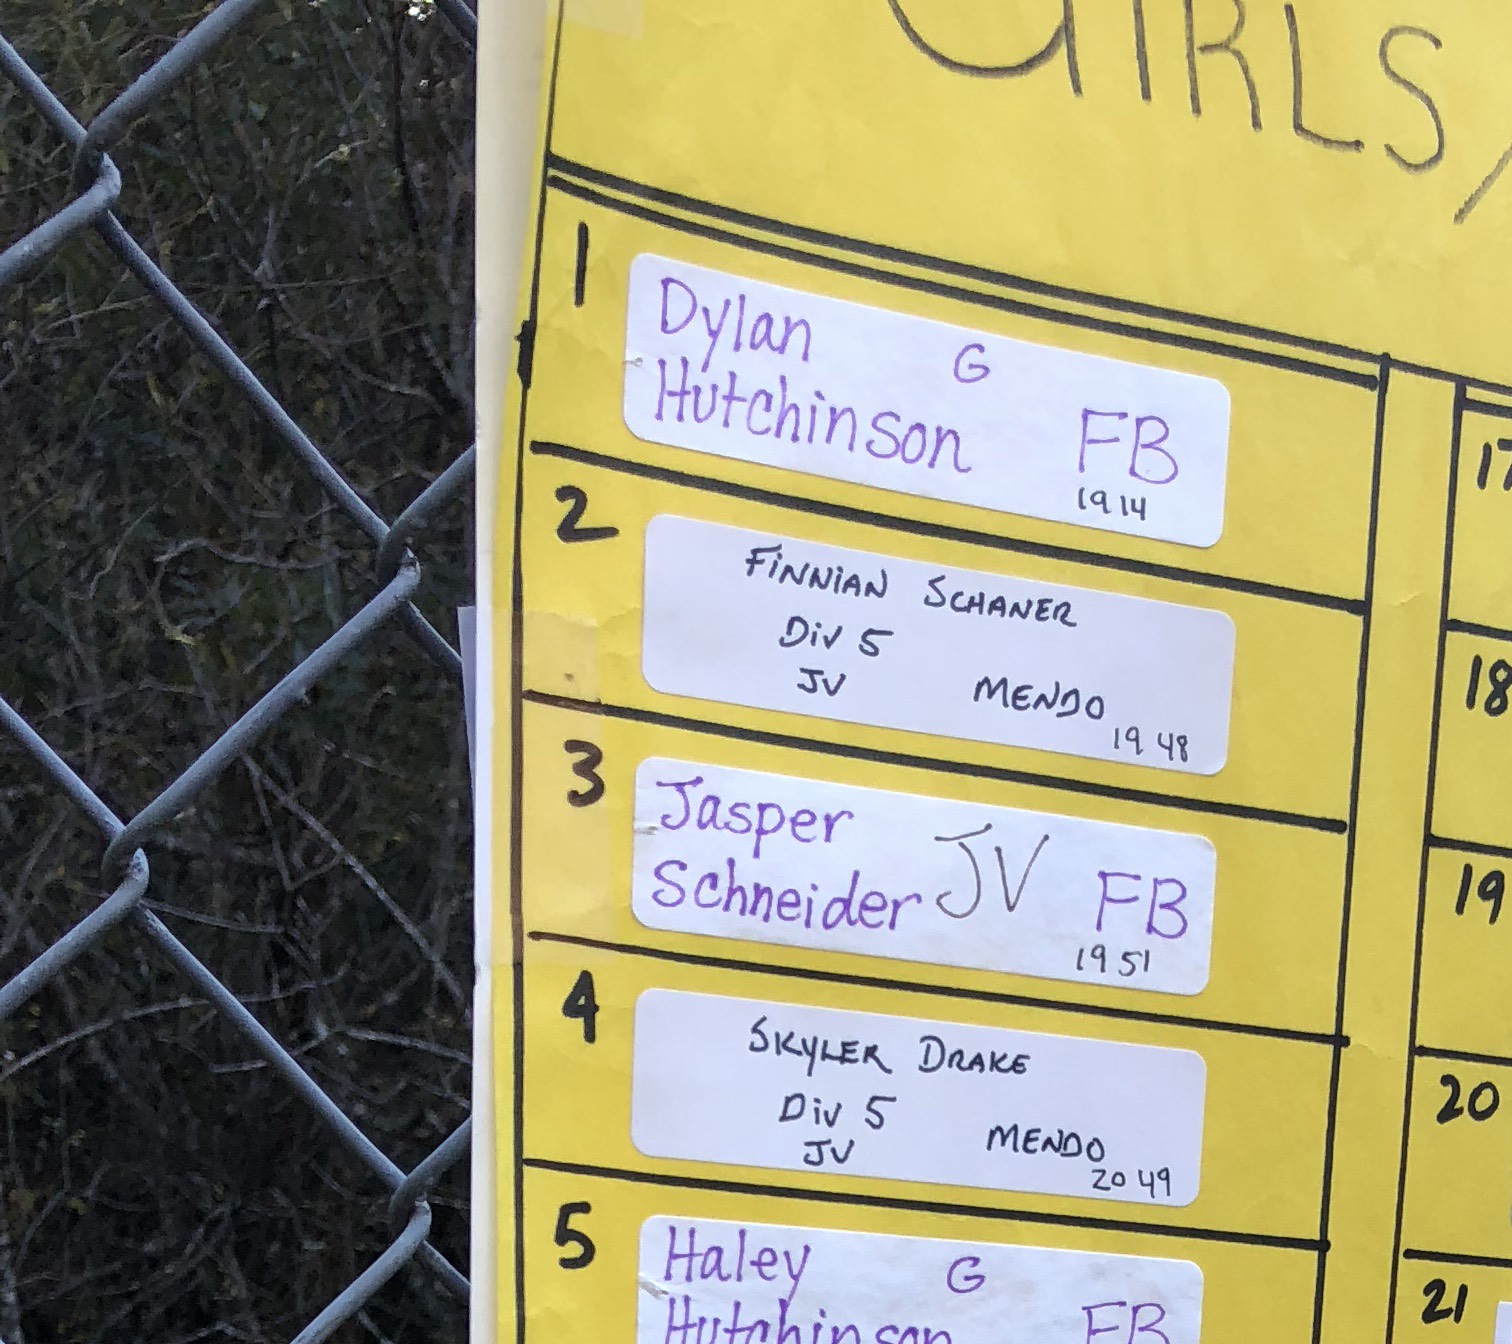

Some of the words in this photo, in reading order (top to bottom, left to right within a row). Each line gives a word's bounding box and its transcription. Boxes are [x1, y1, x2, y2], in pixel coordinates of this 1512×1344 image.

[574, 221, 589, 307] 1
[659, 277, 811, 374] Dylan
[954, 343, 990, 383] G
[655, 356, 974, 473] Hutchinson
[1079, 408, 1178, 484] FB
[555, 485, 619, 544] 2
[974, 676, 1104, 720] MENDO
[564, 739, 605, 808] 3
[656, 776, 854, 859] Jasper
[652, 858, 922, 930] Schneider
[934, 823, 1049, 919] JV
[1096, 871, 1188, 939] FB
[1455, 862, 1505, 925] 19
[749, 1015, 893, 1077] SKYLER
[918, 1035, 1031, 1074] DRAKE
[1436, 1074, 1499, 1125] 20
[554, 1201, 596, 1270] 5
[664, 1225, 811, 1301] Haley
